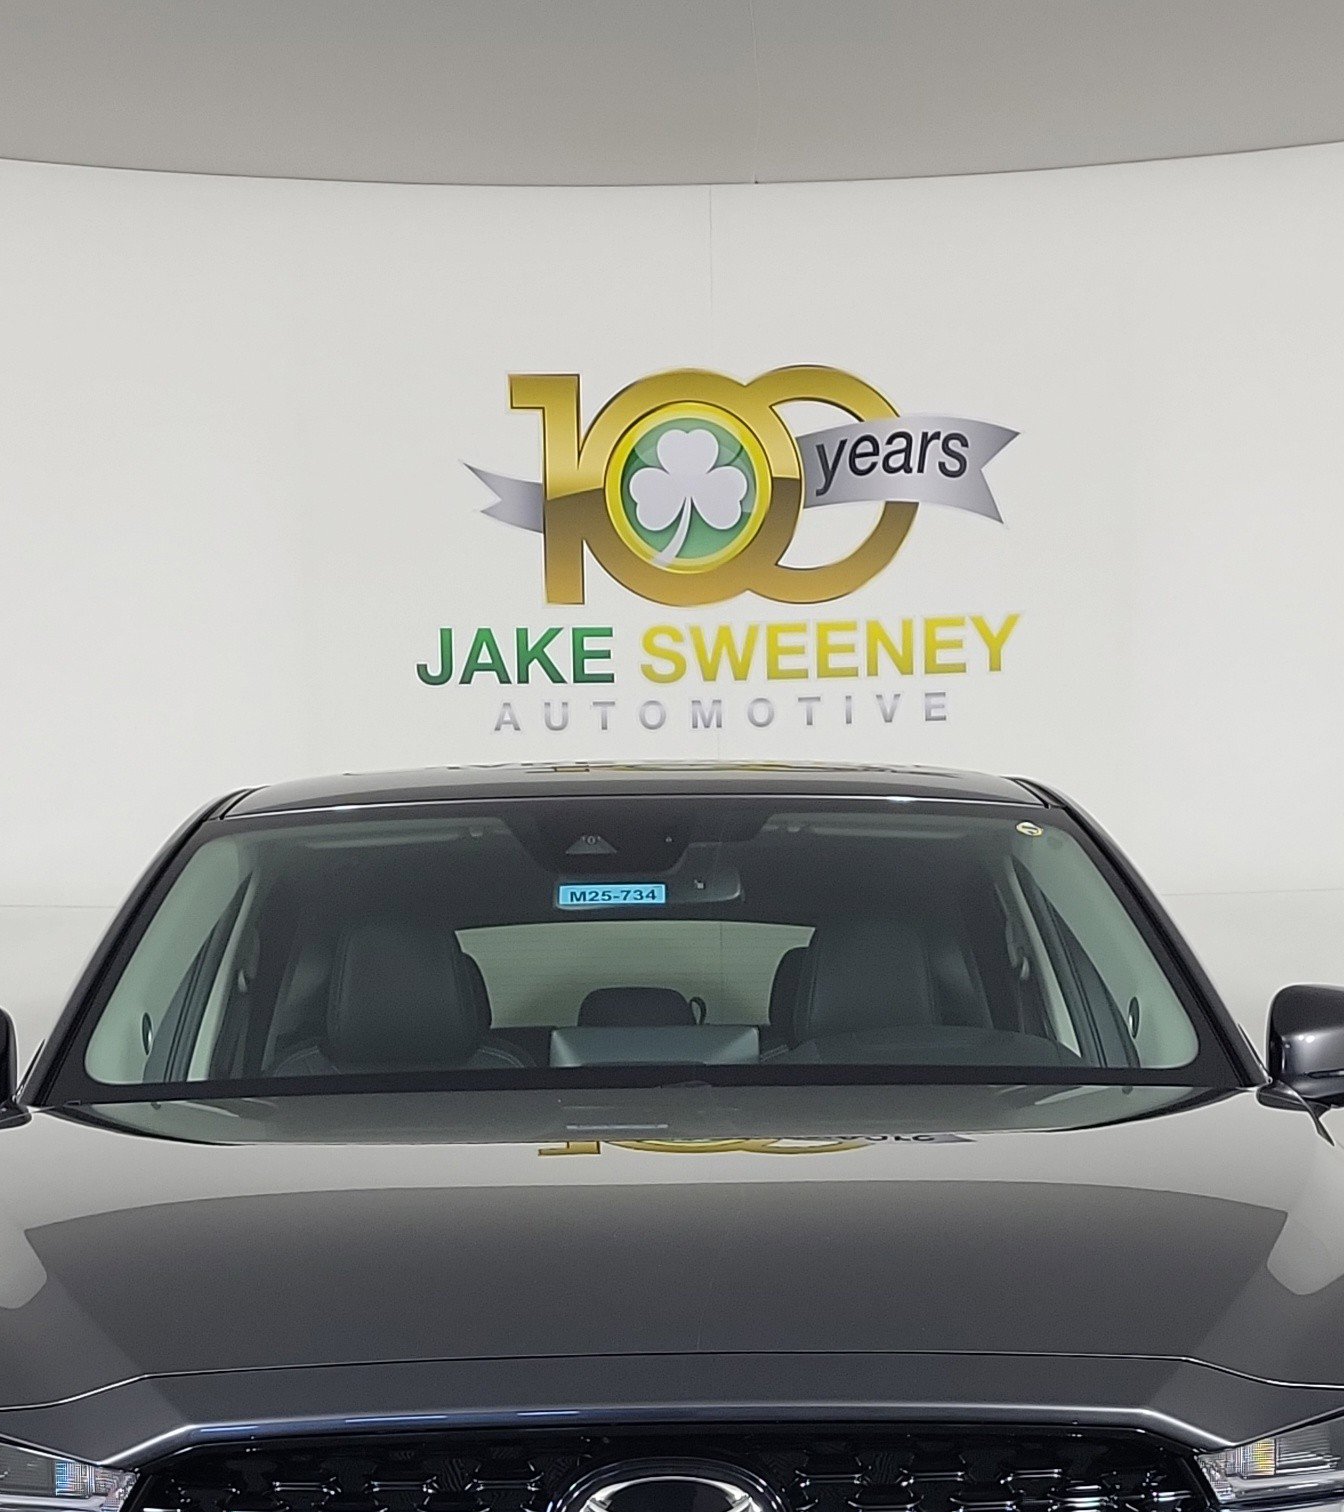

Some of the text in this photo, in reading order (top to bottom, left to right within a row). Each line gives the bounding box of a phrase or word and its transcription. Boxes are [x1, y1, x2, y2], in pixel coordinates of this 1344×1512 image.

[507, 364, 972, 607] 100 years
[416, 613, 1020, 686] JAKE SWEENEY
[494, 692, 948, 732] AUTOMOTIVE
[569, 889, 657, 902] M25-734
